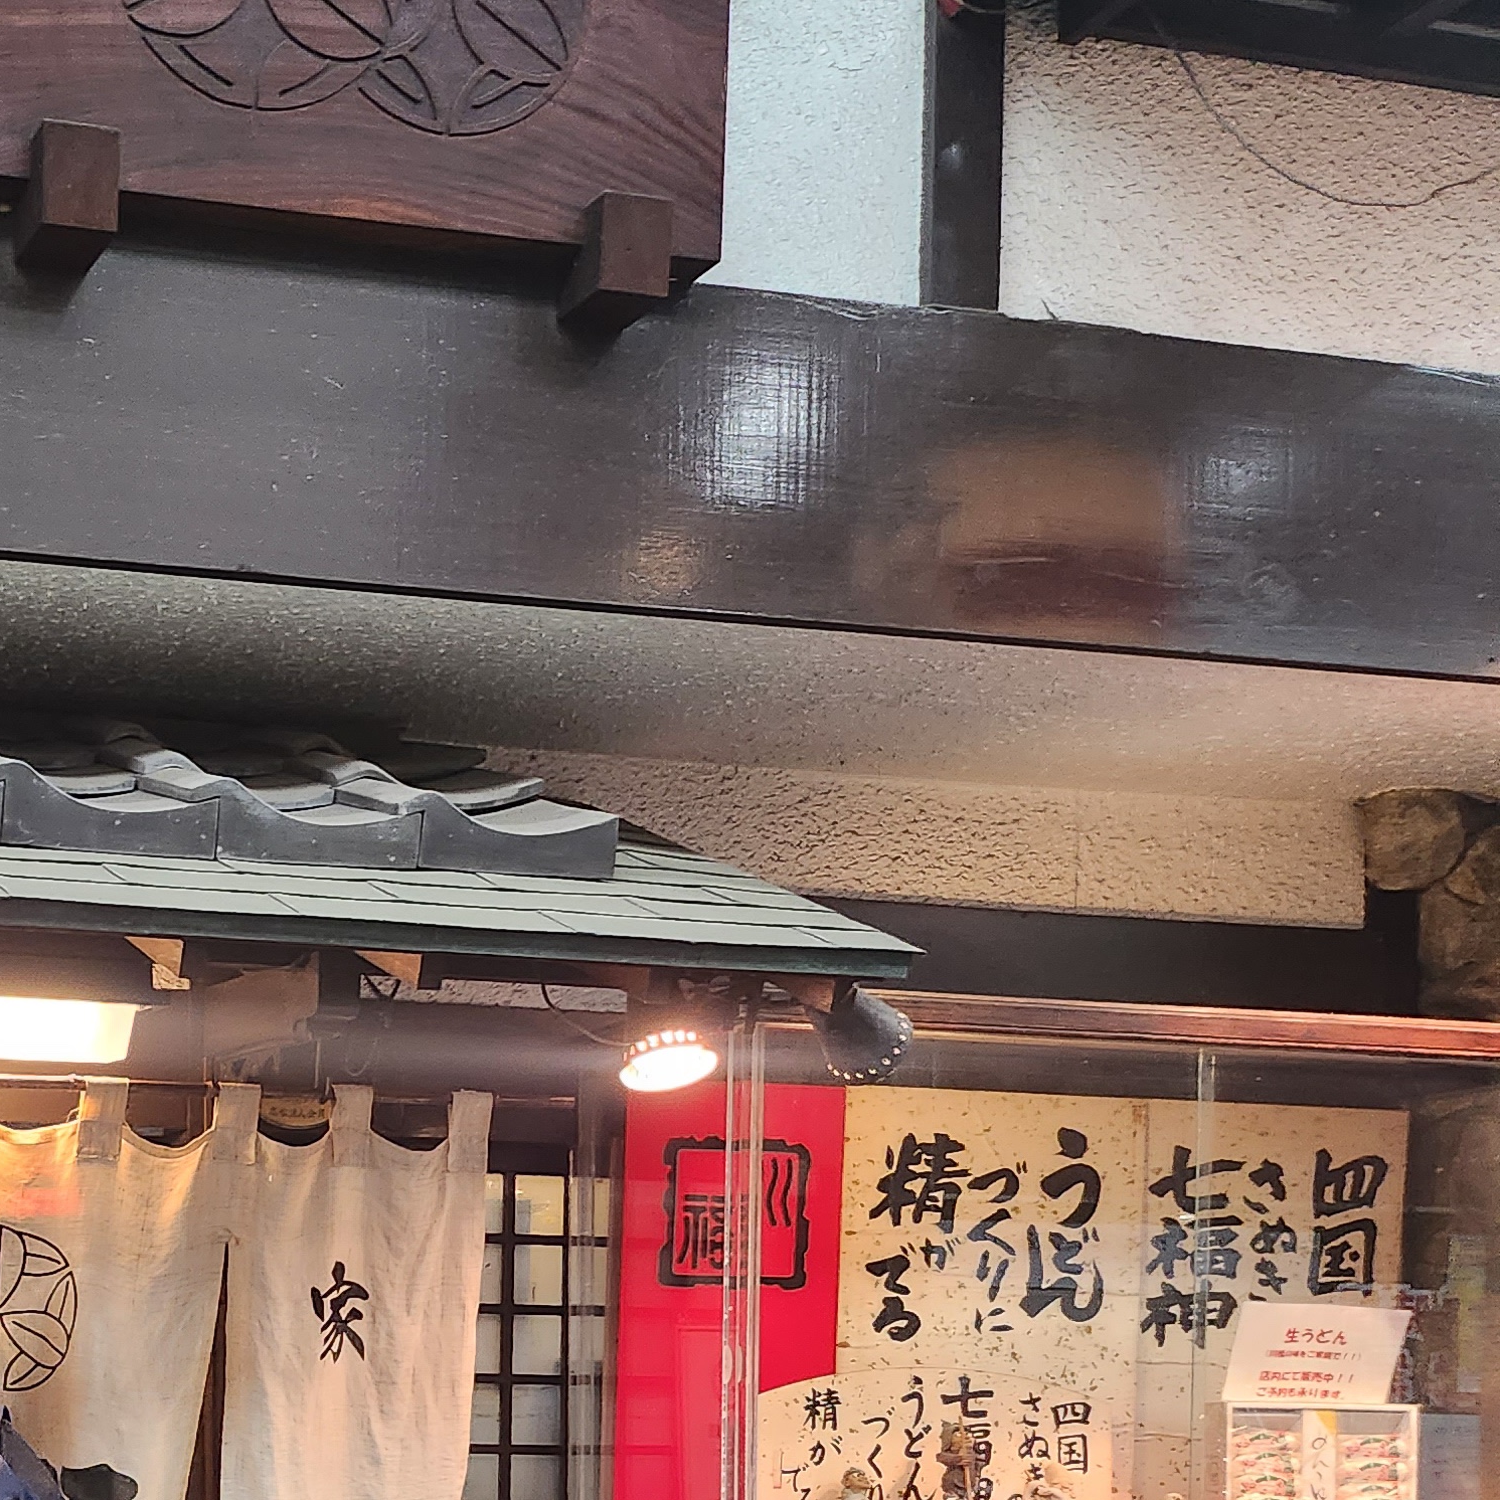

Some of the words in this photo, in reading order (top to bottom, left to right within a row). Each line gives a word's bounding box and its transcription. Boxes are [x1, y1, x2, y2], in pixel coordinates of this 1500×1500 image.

[966, 1160, 1029, 1334] づくりに
[1019, 1127, 1105, 1323] うどん
[1140, 1145, 1246, 1349] 七福神
[1241, 1158, 1298, 1302] さぬき
[1307, 1148, 1389, 1297] 四国
[310, 1261, 370, 1364] 家
[1284, 1327, 1348, 1346] 生うどん
[1050, 1401, 1093, 1474] 四国
